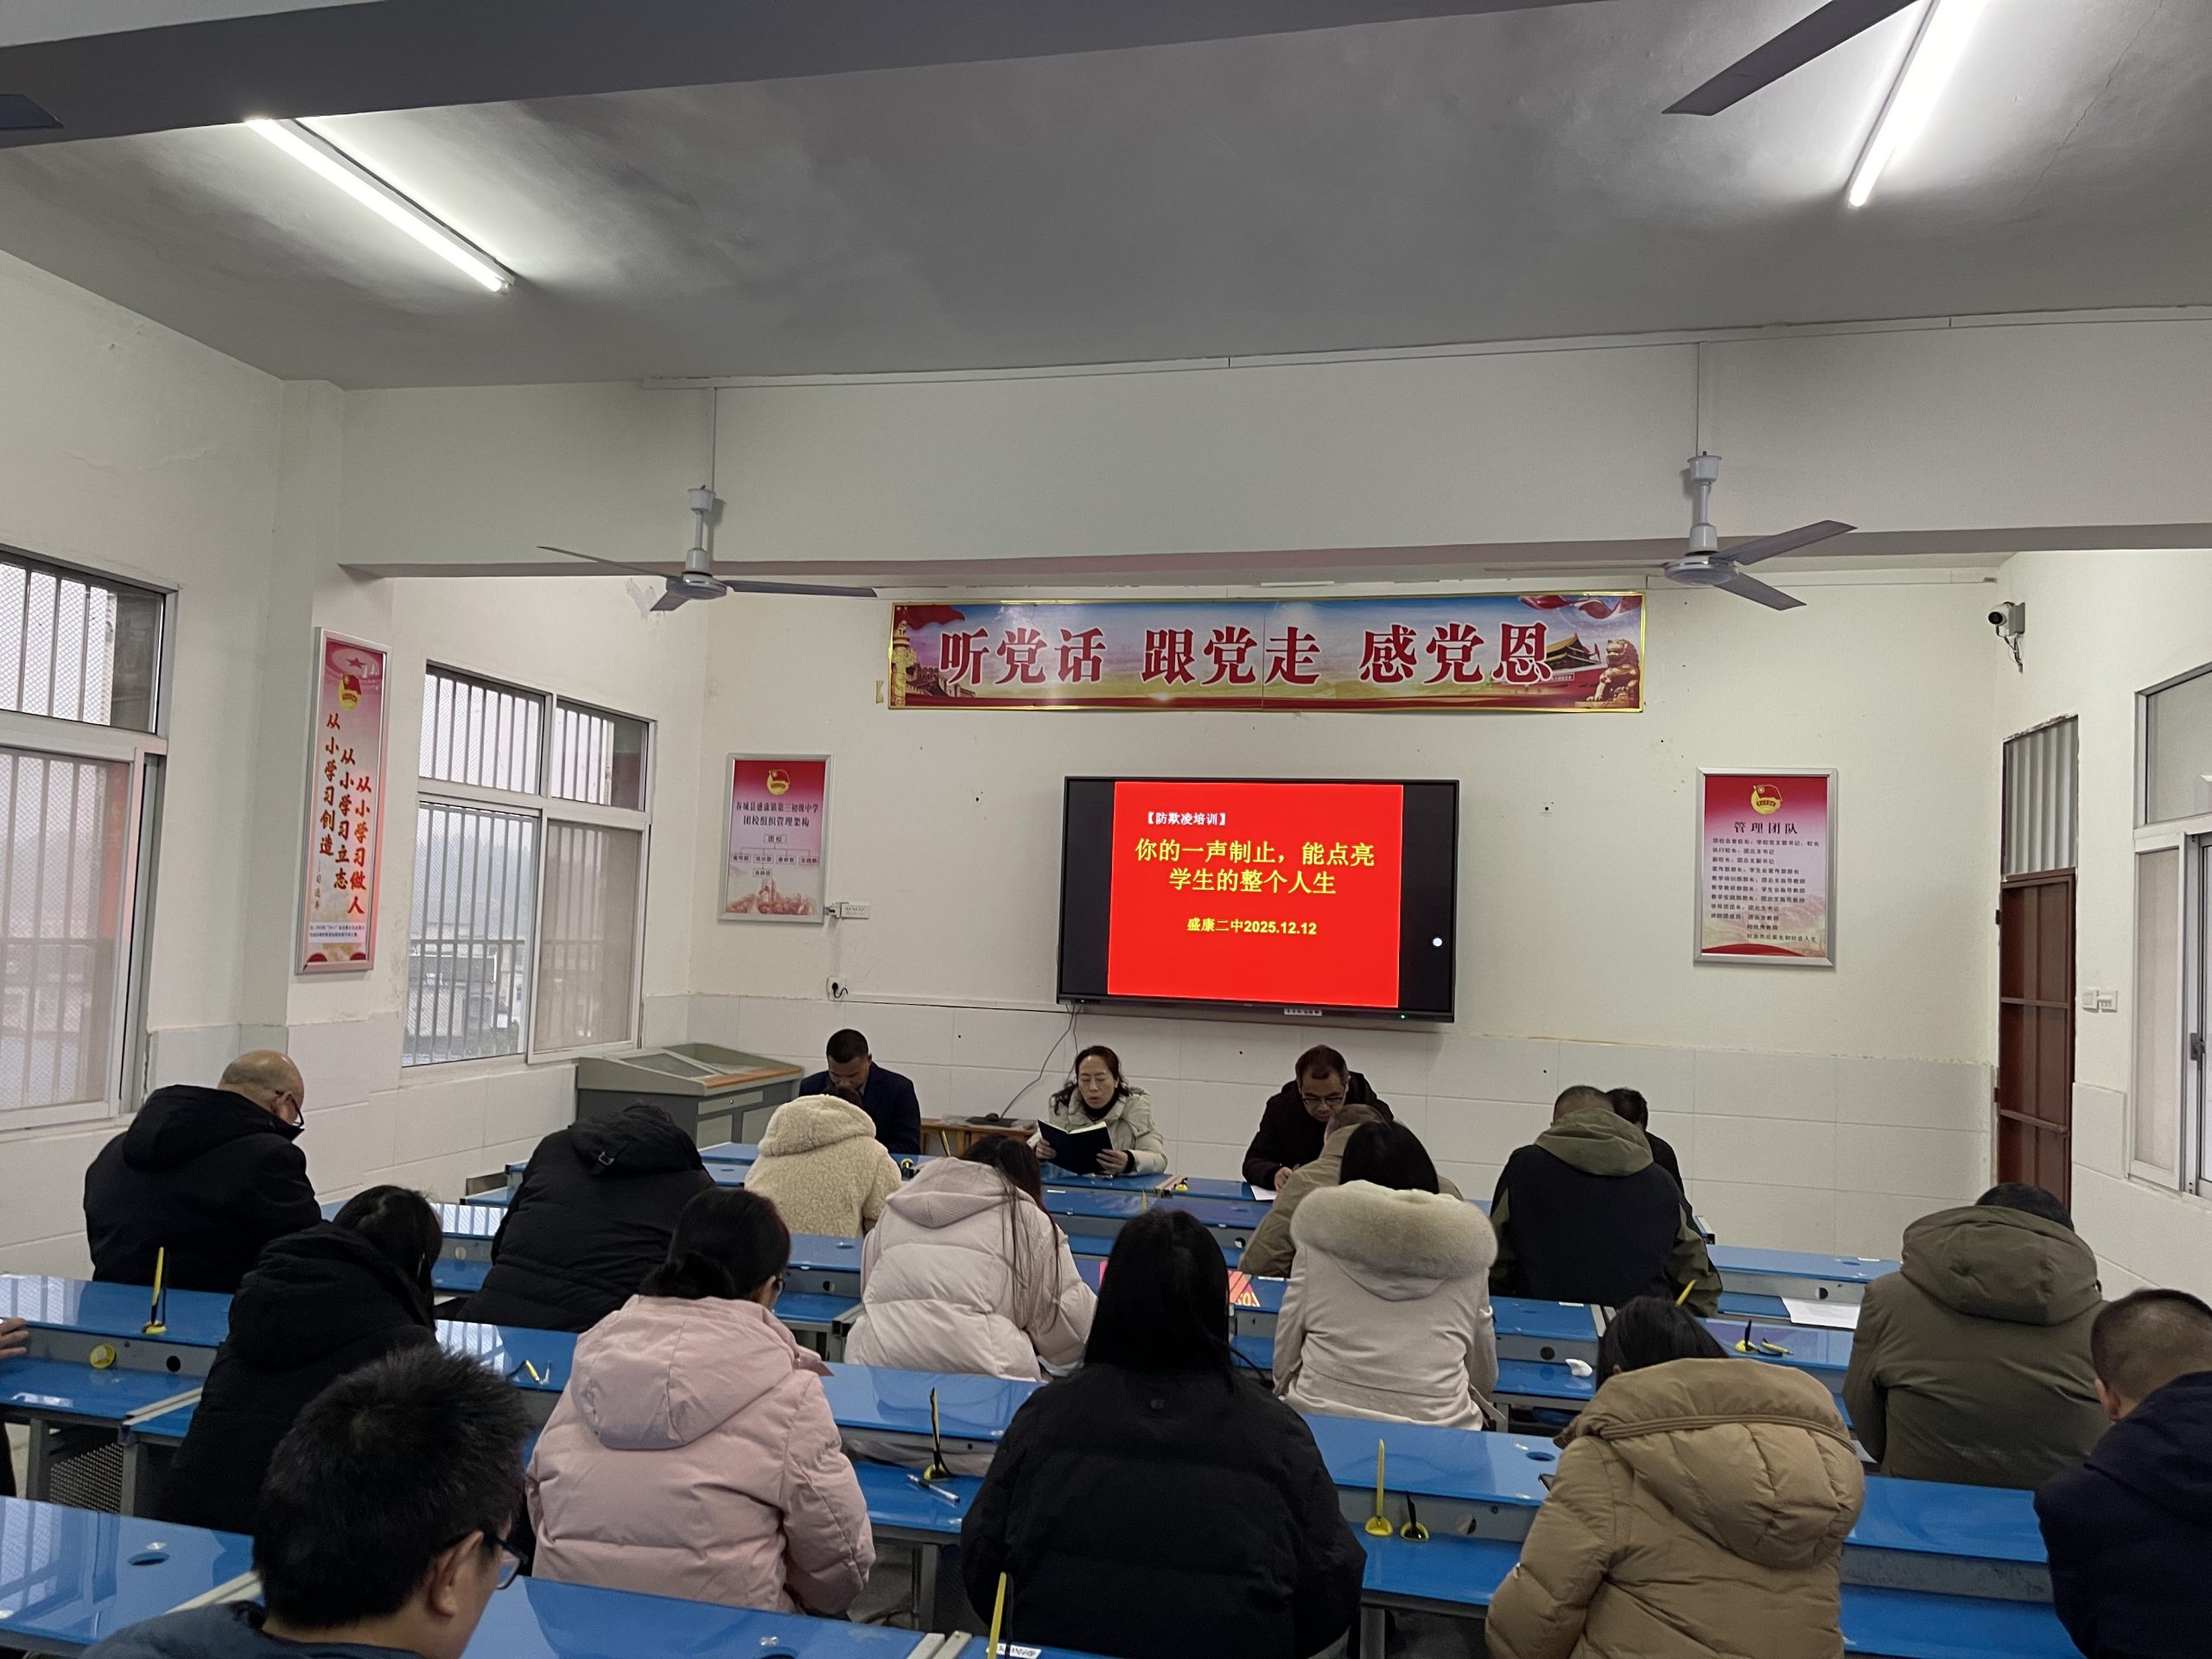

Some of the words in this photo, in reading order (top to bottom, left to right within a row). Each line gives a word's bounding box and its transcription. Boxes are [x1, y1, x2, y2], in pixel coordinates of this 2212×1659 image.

[939, 626, 1107, 684] 听党话
[1141, 626, 1320, 684] 跟党走
[1359, 621, 1555, 687] 感党恩
[320, 713, 340, 856] 从小学习创造
[334, 748, 355, 890] 从小学习立志
[1147, 811, 1226, 826] 【防欺凌培训】
[1733, 822, 1798, 835] 管理团队
[347, 776, 372, 914] 从小学习做人
[1135, 837, 1375, 867] 你的一声制止，能点亮
[1169, 868, 1337, 894] 学生的整个人生
[1186, 918, 1317, 935] 盛康二中2025.12.12
